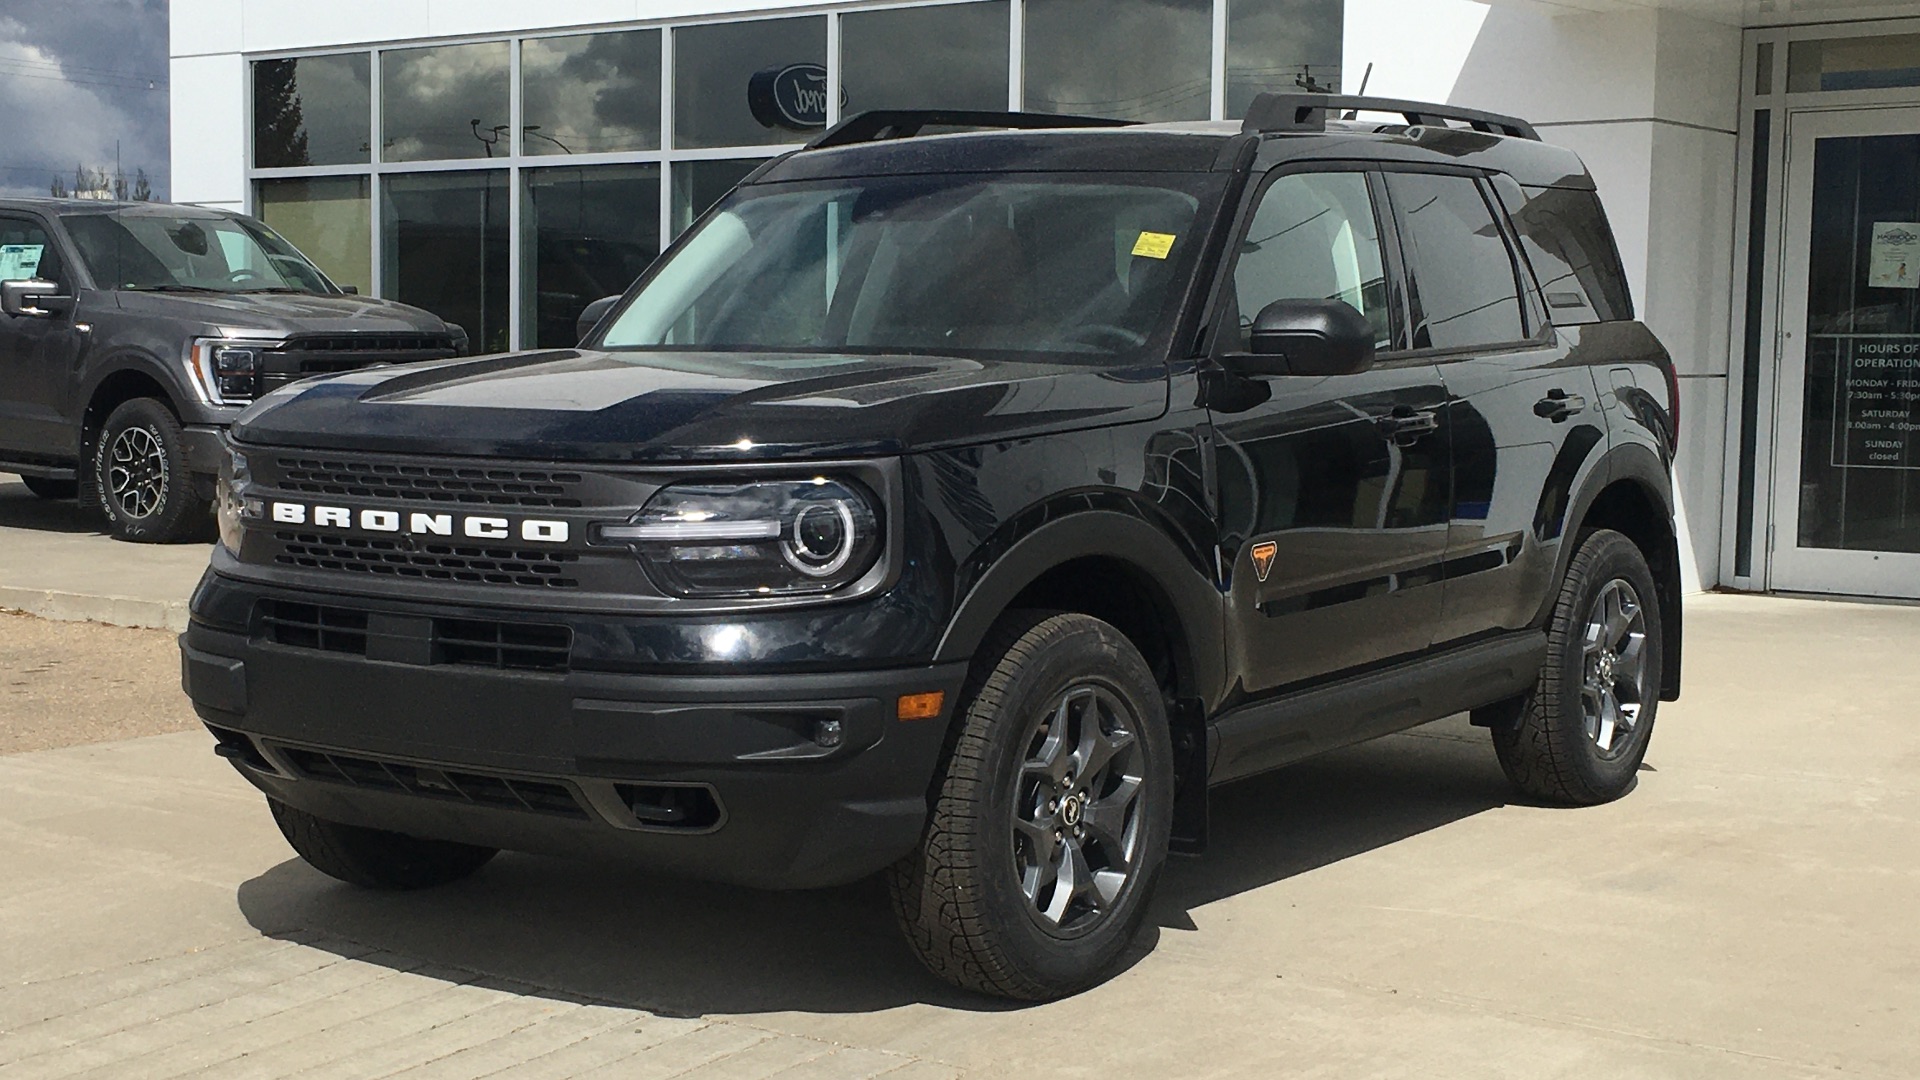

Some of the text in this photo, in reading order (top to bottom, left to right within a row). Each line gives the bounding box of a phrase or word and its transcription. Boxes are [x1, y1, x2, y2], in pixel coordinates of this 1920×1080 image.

[1859, 344, 1919, 353] HOURS OF
[1855, 358, 1920, 368] OPERATION
[1845, 379, 1889, 387] MONDAY
[1847, 391, 1883, 400] 7:30am
[1861, 409, 1911, 418] SATURDAY
[1864, 440, 1904, 449] SUNDAY
[1868, 452, 1899, 461] closed
[272, 501, 569, 543] BRONCO
